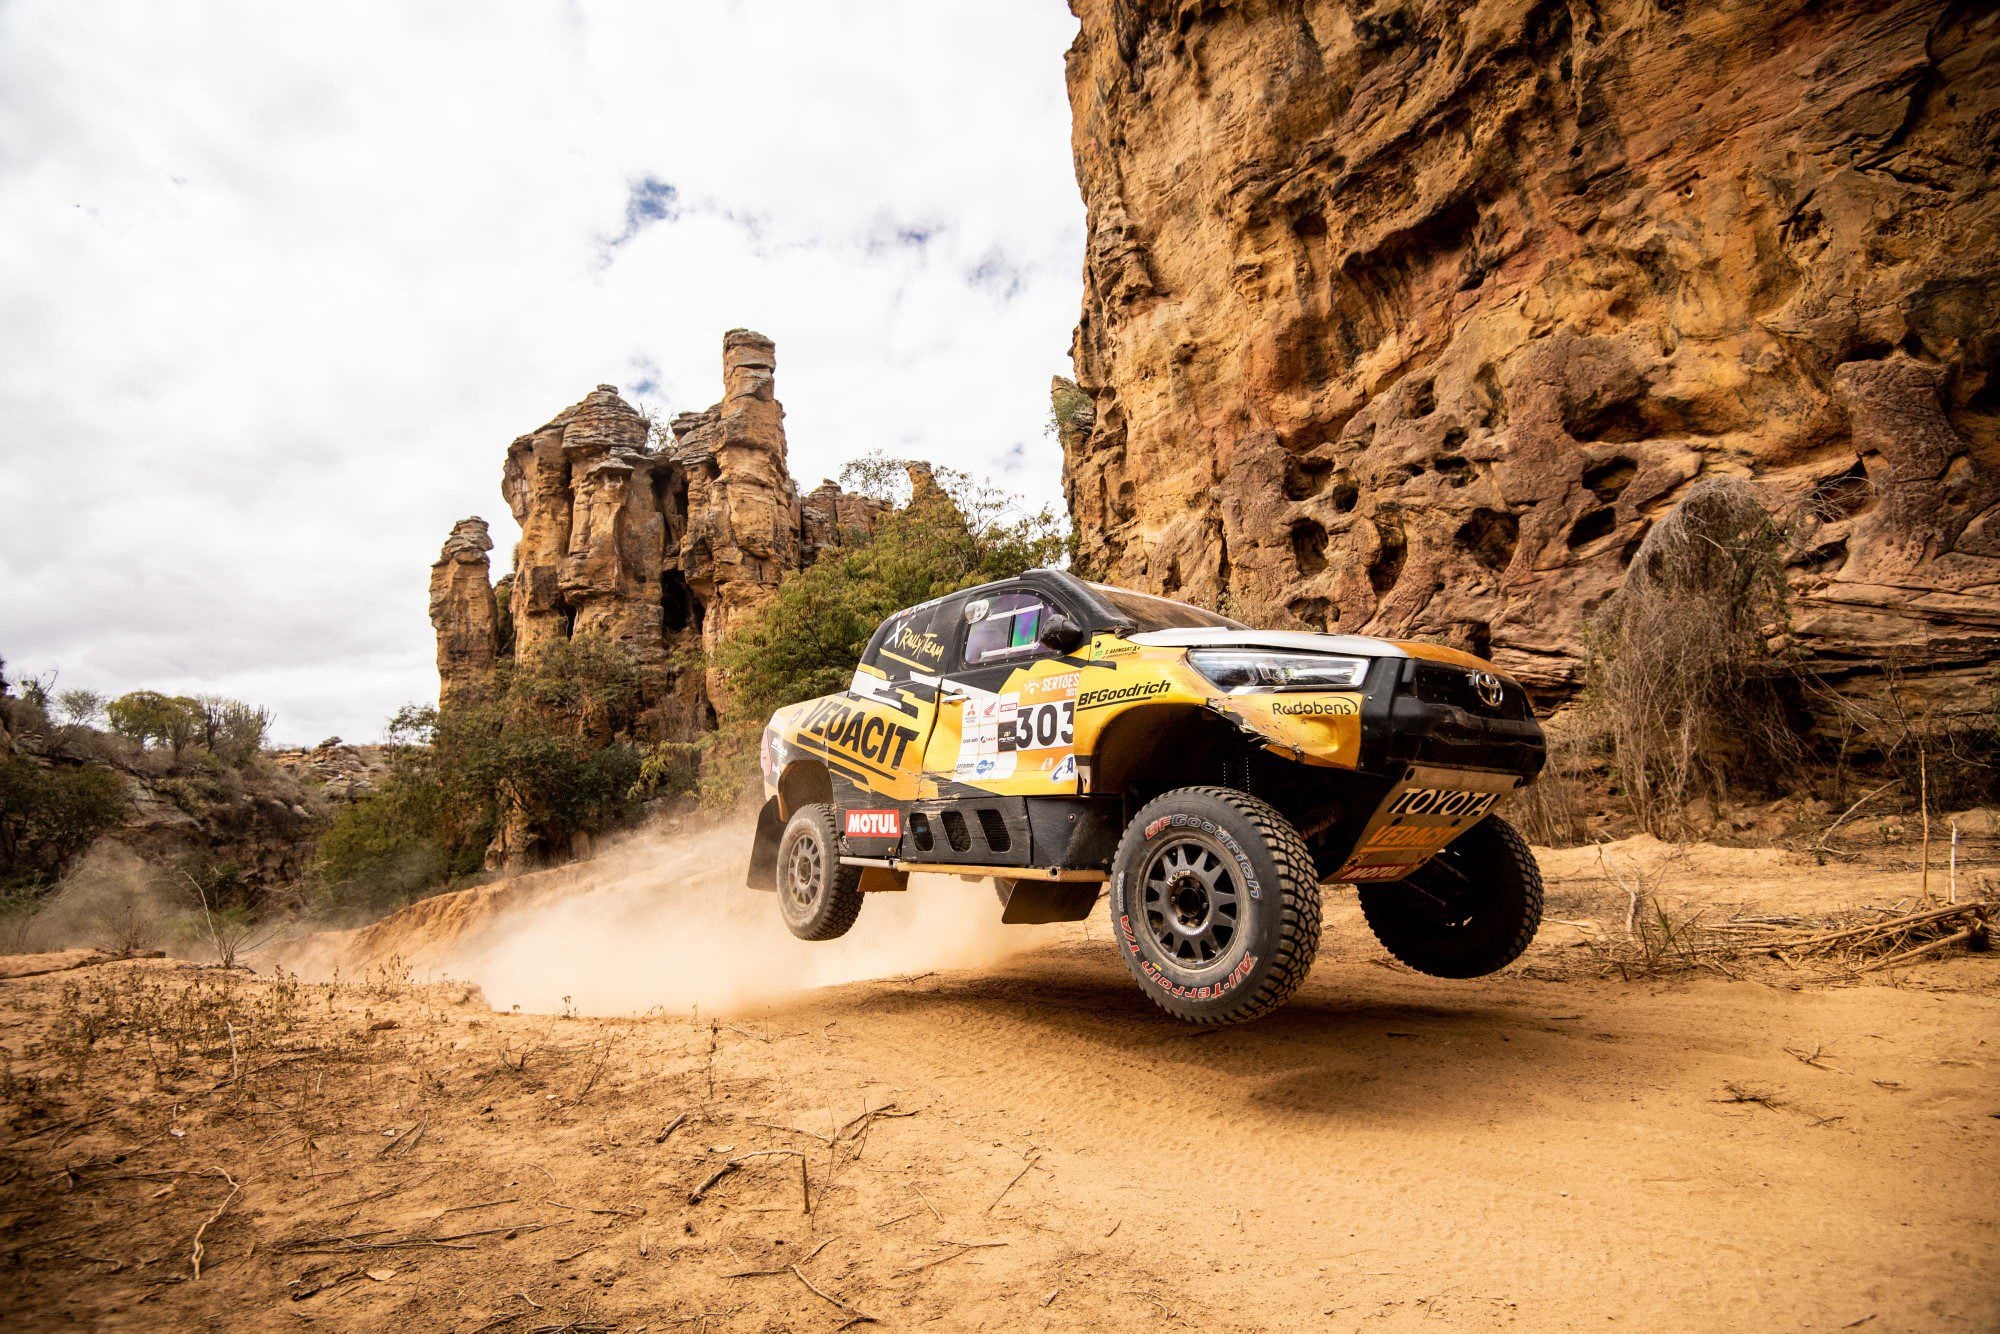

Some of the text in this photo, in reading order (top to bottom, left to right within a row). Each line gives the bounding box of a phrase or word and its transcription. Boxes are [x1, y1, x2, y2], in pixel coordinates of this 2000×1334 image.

[884, 619, 909, 649] X
[1077, 680, 1171, 706] BFGoodrich
[1015, 702, 1075, 749] 303
[1390, 788, 1497, 817] TOYOTA
[847, 813, 898, 834] MOTUL
[1145, 813, 1262, 899] BFGoodrich
